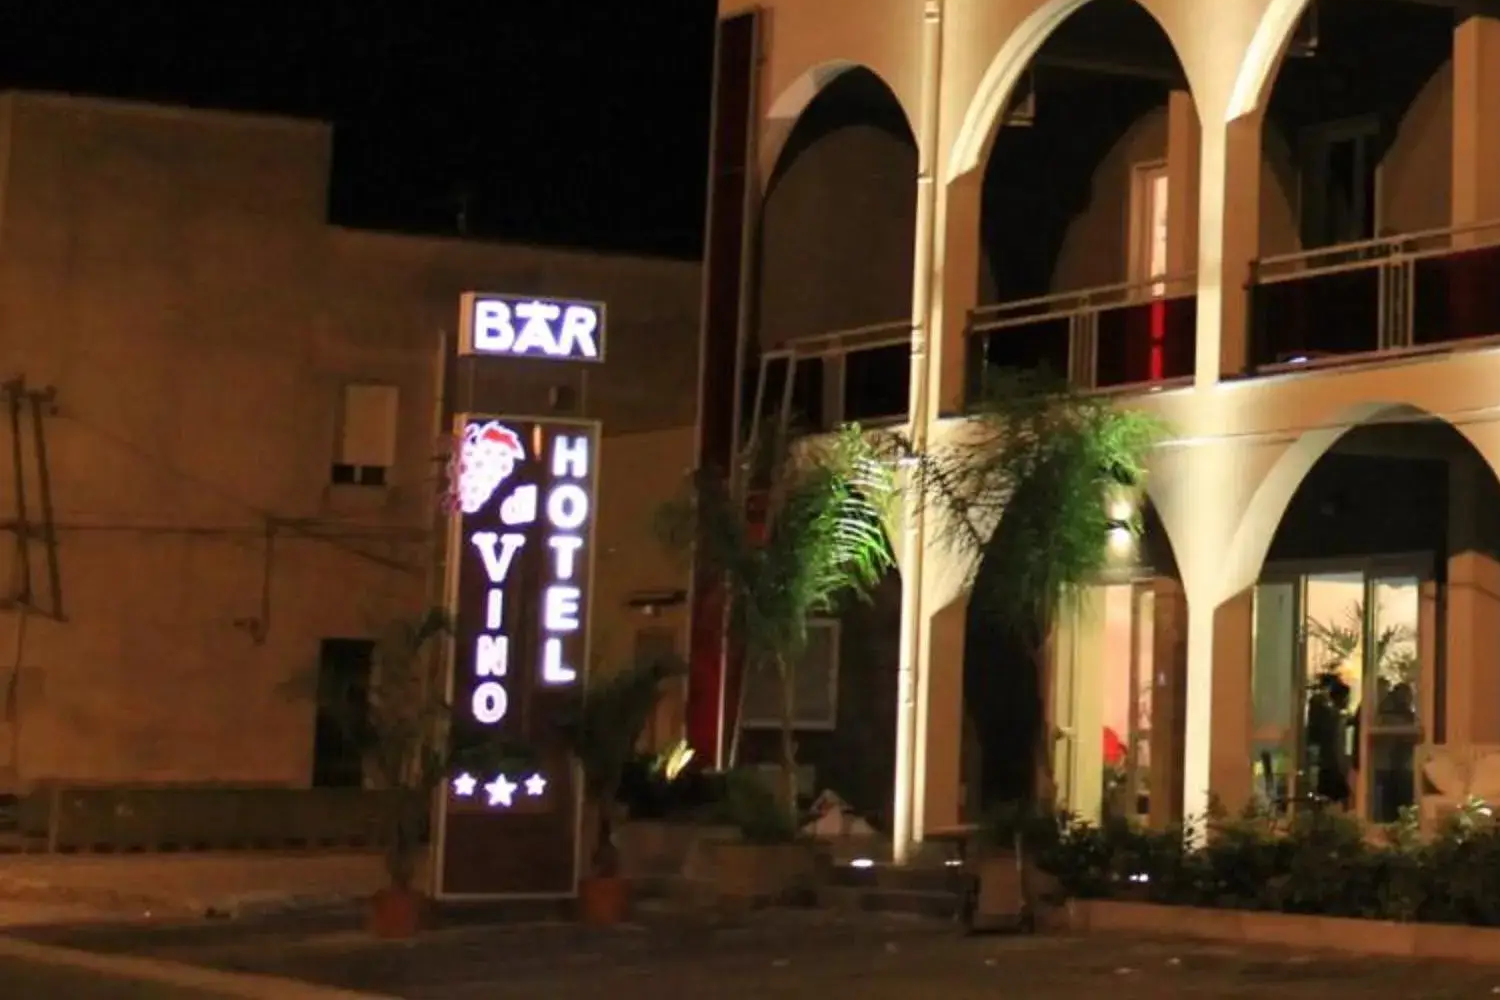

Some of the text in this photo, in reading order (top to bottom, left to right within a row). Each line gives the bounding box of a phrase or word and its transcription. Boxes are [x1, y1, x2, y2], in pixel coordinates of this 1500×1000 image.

[474, 300, 597, 357] BAR
[471, 532, 526, 723] VINO
[543, 435, 589, 683] HOTEL
